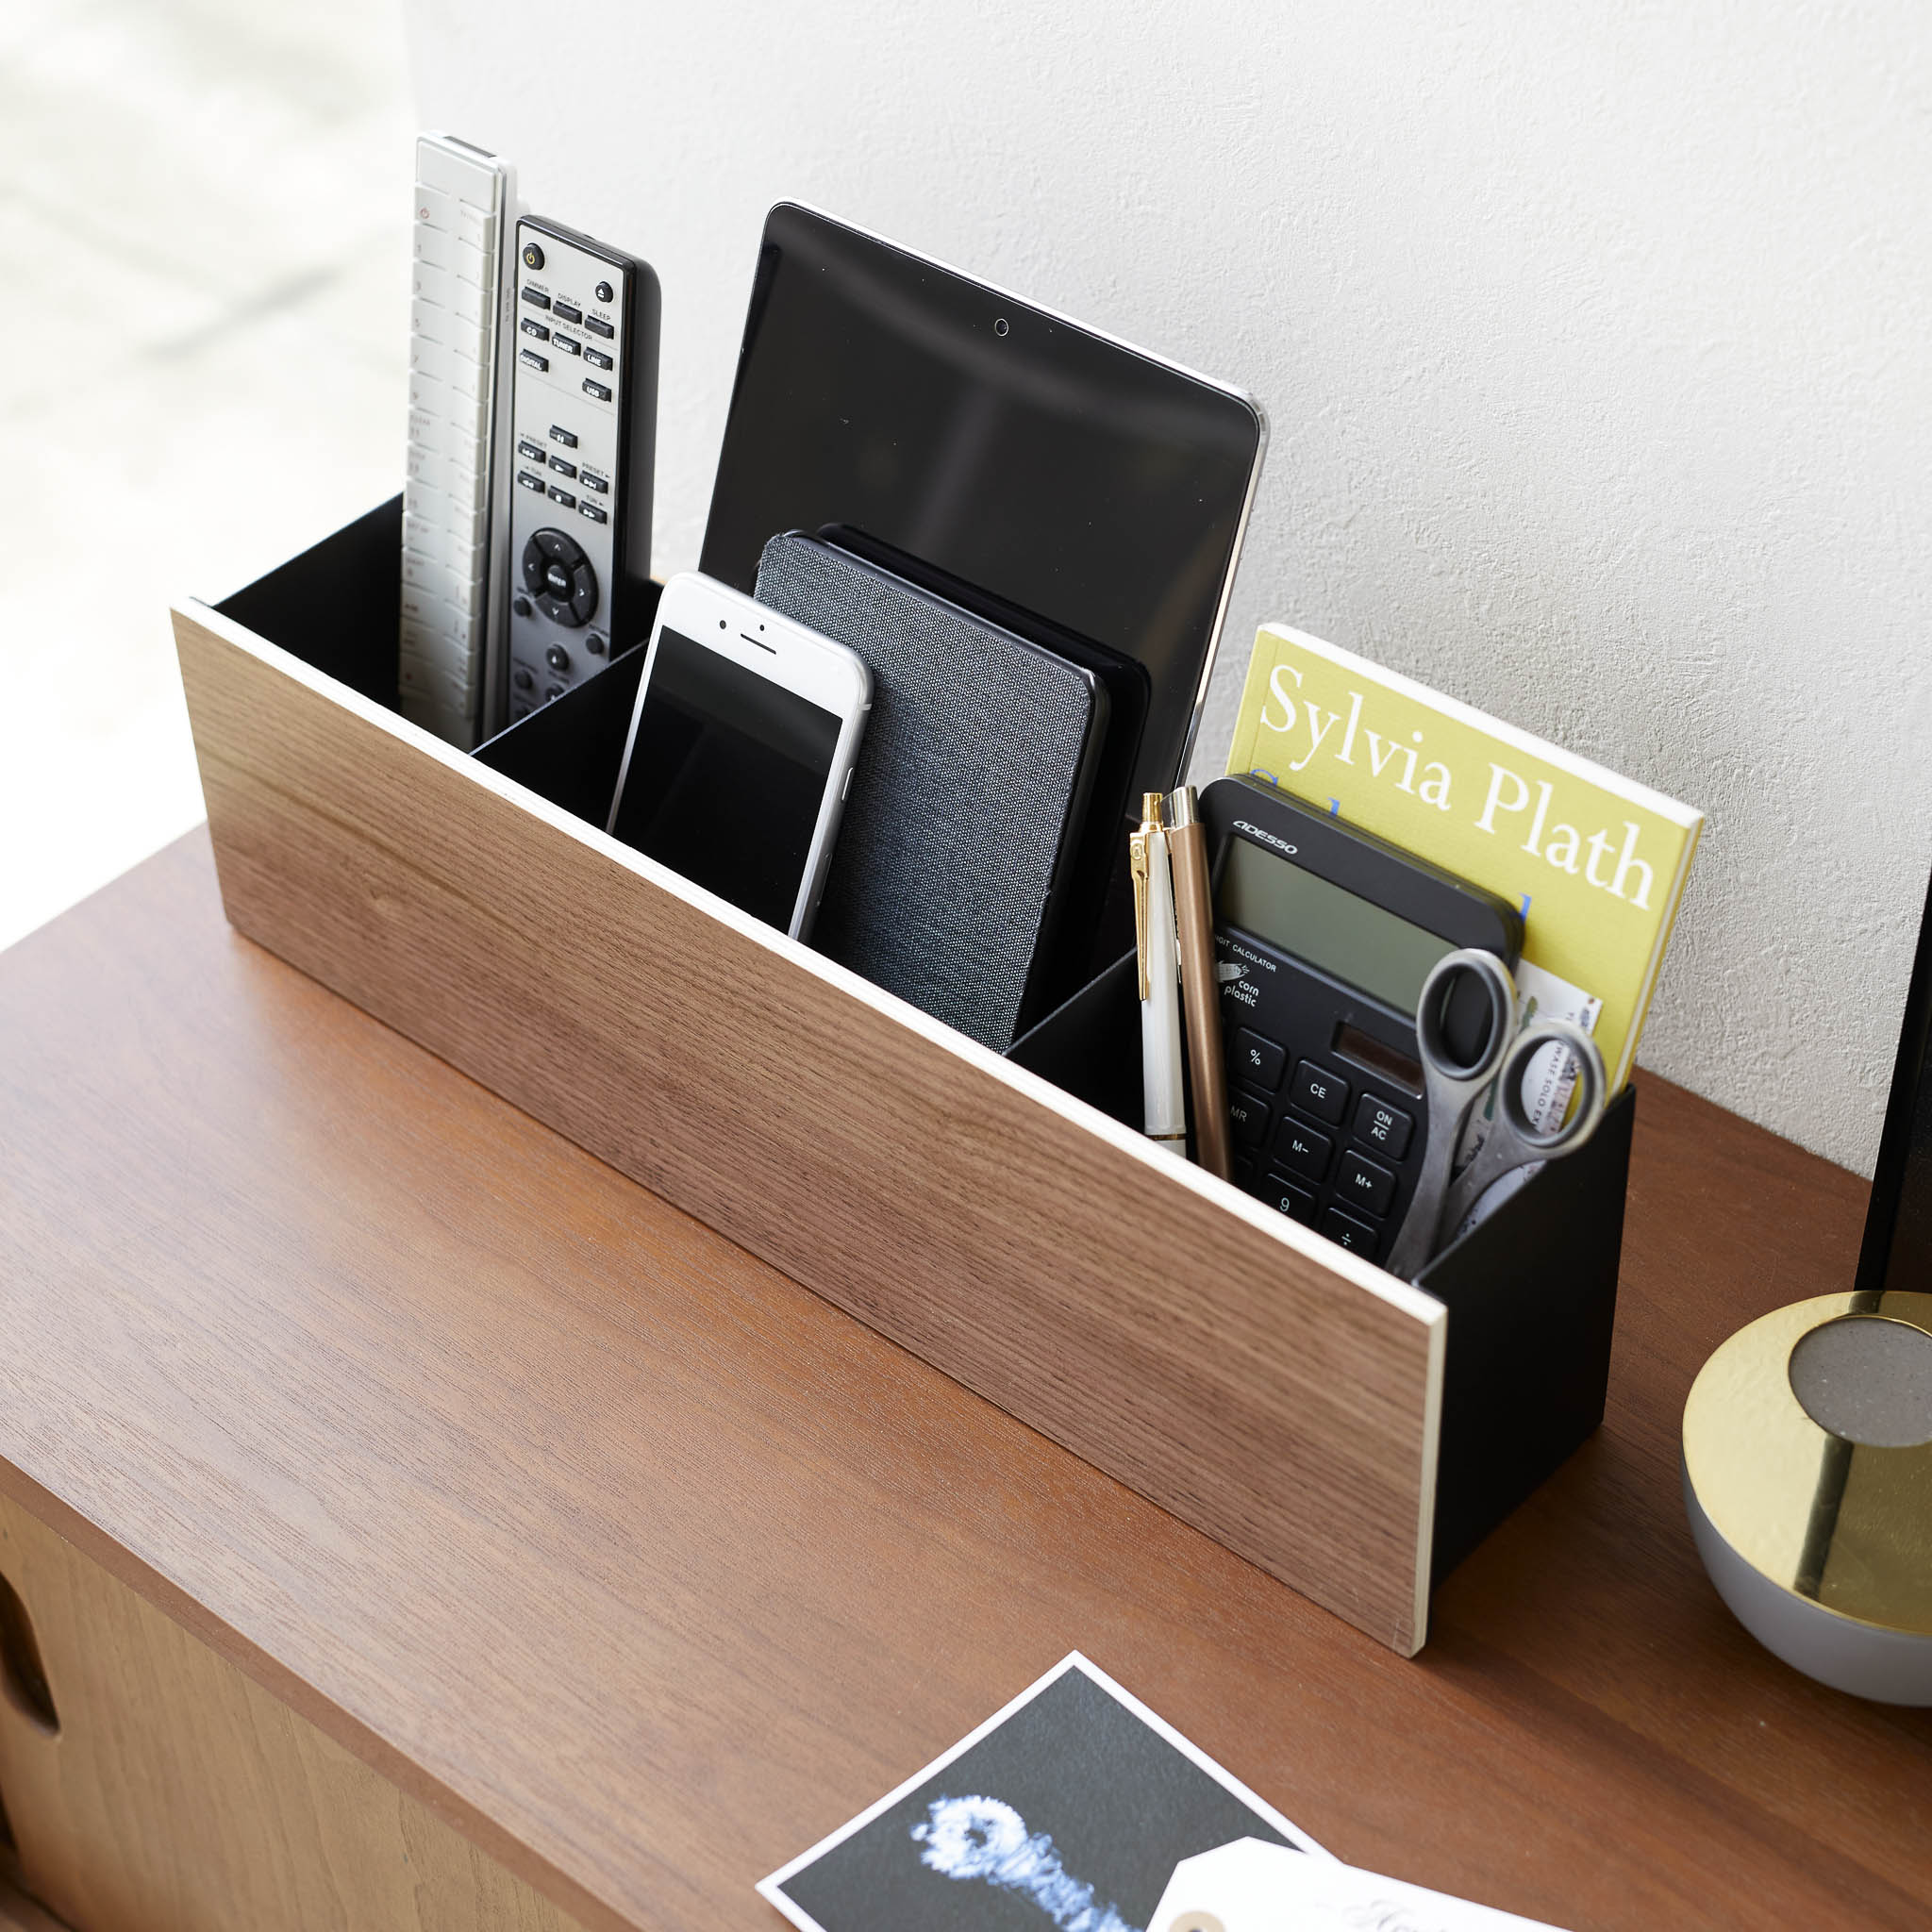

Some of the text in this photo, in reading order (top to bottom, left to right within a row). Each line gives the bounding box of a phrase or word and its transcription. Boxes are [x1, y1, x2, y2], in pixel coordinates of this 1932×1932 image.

[558, 292, 581, 308] DISPLAY
[591, 308, 611, 321] SLEEP
[563, 322, 592, 340] SELECTOR
[553, 338, 573, 353] TUNER
[587, 355, 602, 367] LINE
[586, 385, 600, 397] USB
[1259, 664, 1655, 911] Sylvia Plath
[1233, 820, 1298, 856] ADESSO
[1215, 935, 1276, 973] IGIT CALCULATOR
[1224, 984, 1257, 1008] plastic
[1238, 980, 1259, 996] corn
[1309, 1083, 1326, 1099] CE
[1538, 1078, 1552, 1107] SOLO
[1230, 1106, 1247, 1123] MR
[1376, 1110, 1392, 1125] ON
[1371, 1126, 1387, 1140] AC
[1355, 1174, 1373, 1190] M+
[1279, 1197, 1291, 1212] 9
